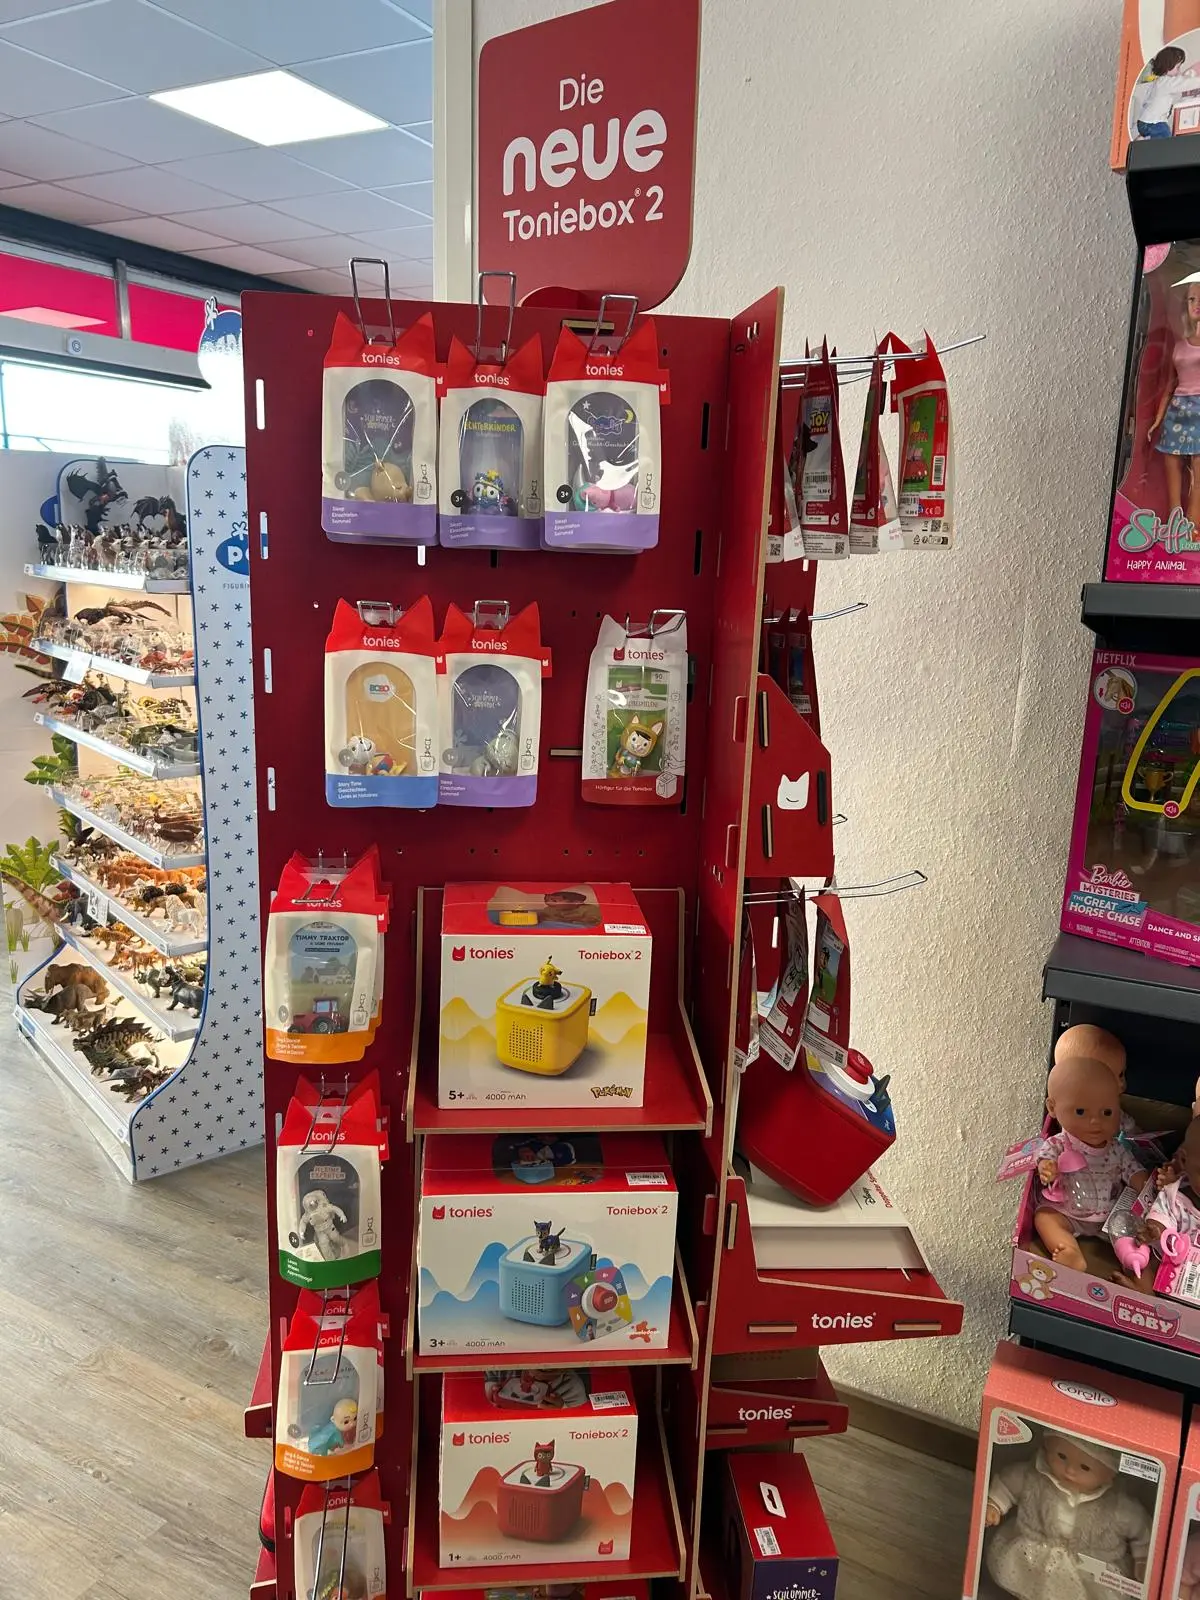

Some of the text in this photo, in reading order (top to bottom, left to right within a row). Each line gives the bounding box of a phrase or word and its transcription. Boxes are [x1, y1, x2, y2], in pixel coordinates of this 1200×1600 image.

[560, 73, 604, 111] Die
[503, 109, 668, 196] neue
[645, 185, 664, 222] 2
[362, 352, 401, 365] tonies
[586, 364, 625, 376] tonies
[475, 373, 511, 386] tonies
[810, 410, 831, 427] TOY
[1118, 506, 1194, 553] Steffi
[363, 635, 401, 648] tonies
[472, 638, 508, 650] tonies
[628, 649, 665, 661] tonies
[1095, 652, 1137, 667] NETFLIX
[1091, 865, 1132, 888] Barbie
[1082, 883, 1136, 902] MYSTERIES
[1073, 894, 1119, 911] THE GREAT
[1069, 901, 1142, 928] HORSE CHASE
[1147, 923, 1173, 936] DANCE
[1174, 931, 1192, 942] AND
[469, 946, 515, 960] tonies
[578, 949, 642, 960] Toniebox 2
[448, 1090, 465, 1100] 5+
[485, 1093, 526, 1101] 4000 mAh
[449, 1206, 494, 1218] tonies
[606, 1205, 669, 1216] Toniebox 2
[1119, 1301, 1133, 1311] NEW
[811, 1313, 874, 1329] tonies
[1118, 1307, 1174, 1333] BABY
[429, 1338, 445, 1348] 3+
[465, 1339, 506, 1348] 4000 mAh
[738, 1407, 794, 1421] tonies
[468, 1431, 511, 1444] tonies
[568, 1428, 629, 1441] Toniebox 2
[448, 1553, 461, 1562] 1+
